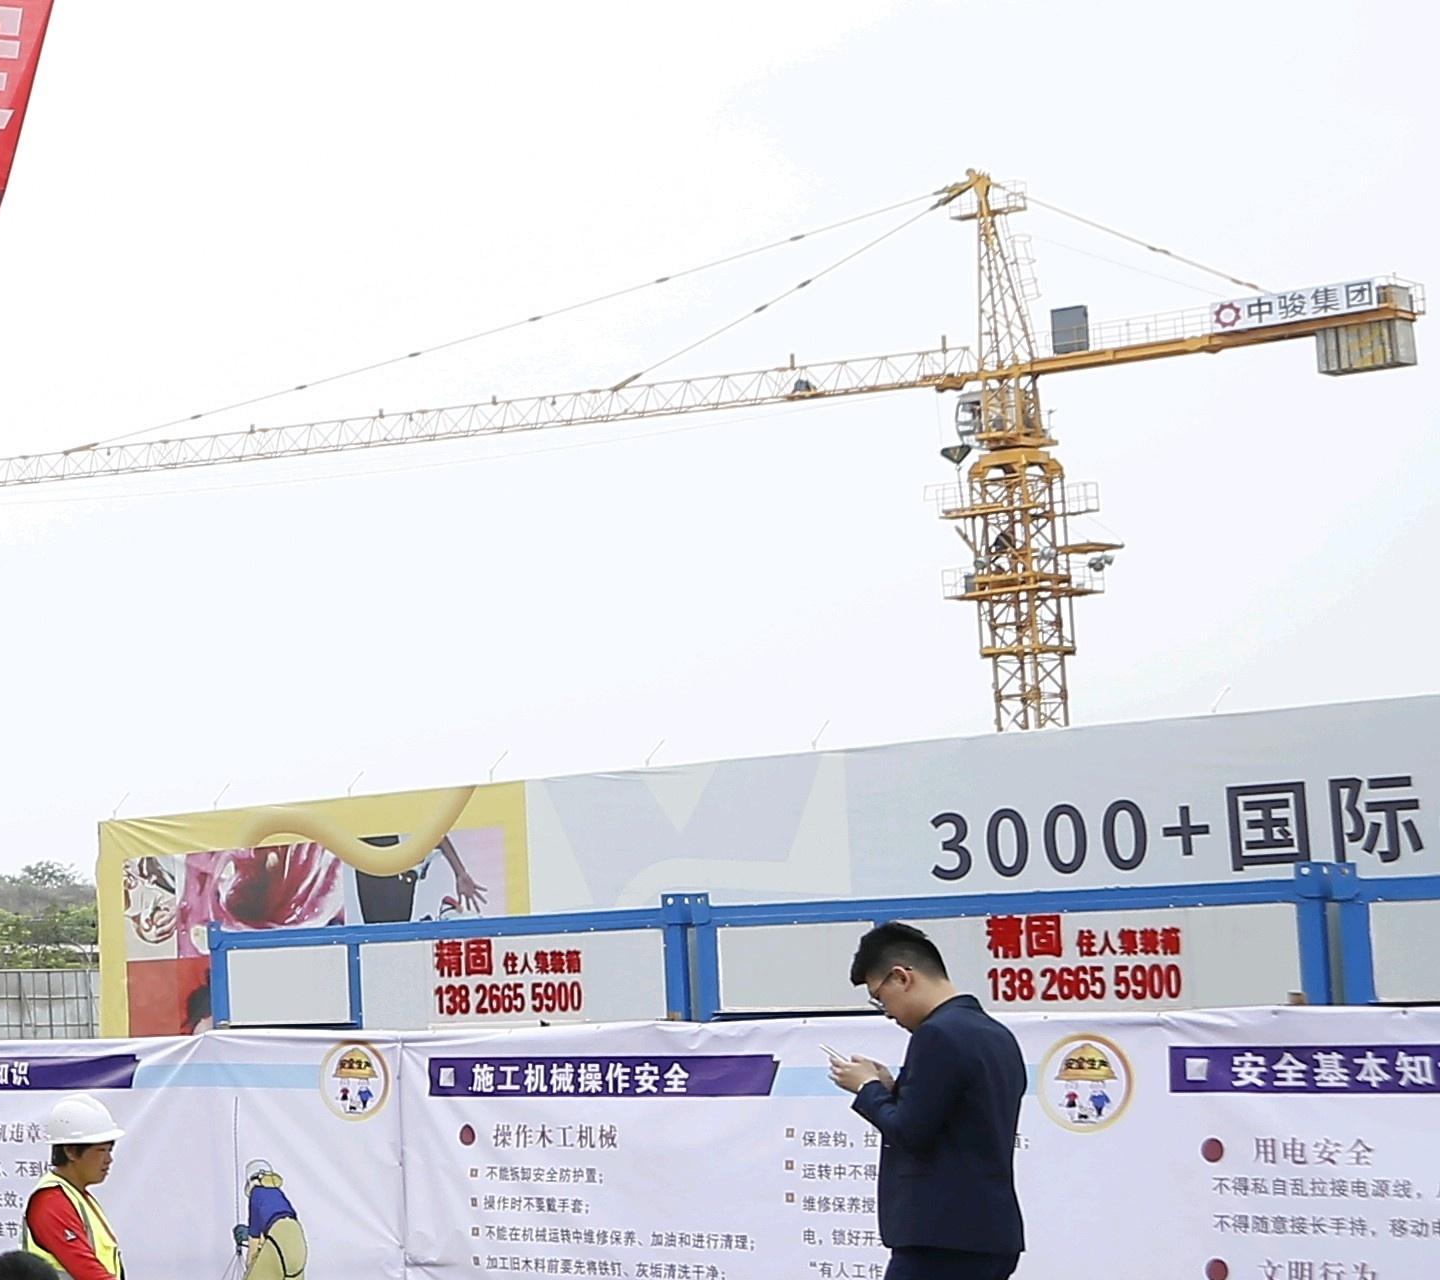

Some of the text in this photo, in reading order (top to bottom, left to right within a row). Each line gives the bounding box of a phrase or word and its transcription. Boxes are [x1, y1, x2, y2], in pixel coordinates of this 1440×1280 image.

[1247, 281, 1374, 324] 中骏集团
[931, 774, 1424, 881] 3000+国际
[434, 981, 582, 1016] 138 2665 5900
[987, 963, 1182, 1002] 138 2665 5900
[1231, 1051, 1440, 1088] 安全基本知
[492, 1124, 619, 1149] 操作木工机械
[1252, 1137, 1376, 1166] 用电安全
